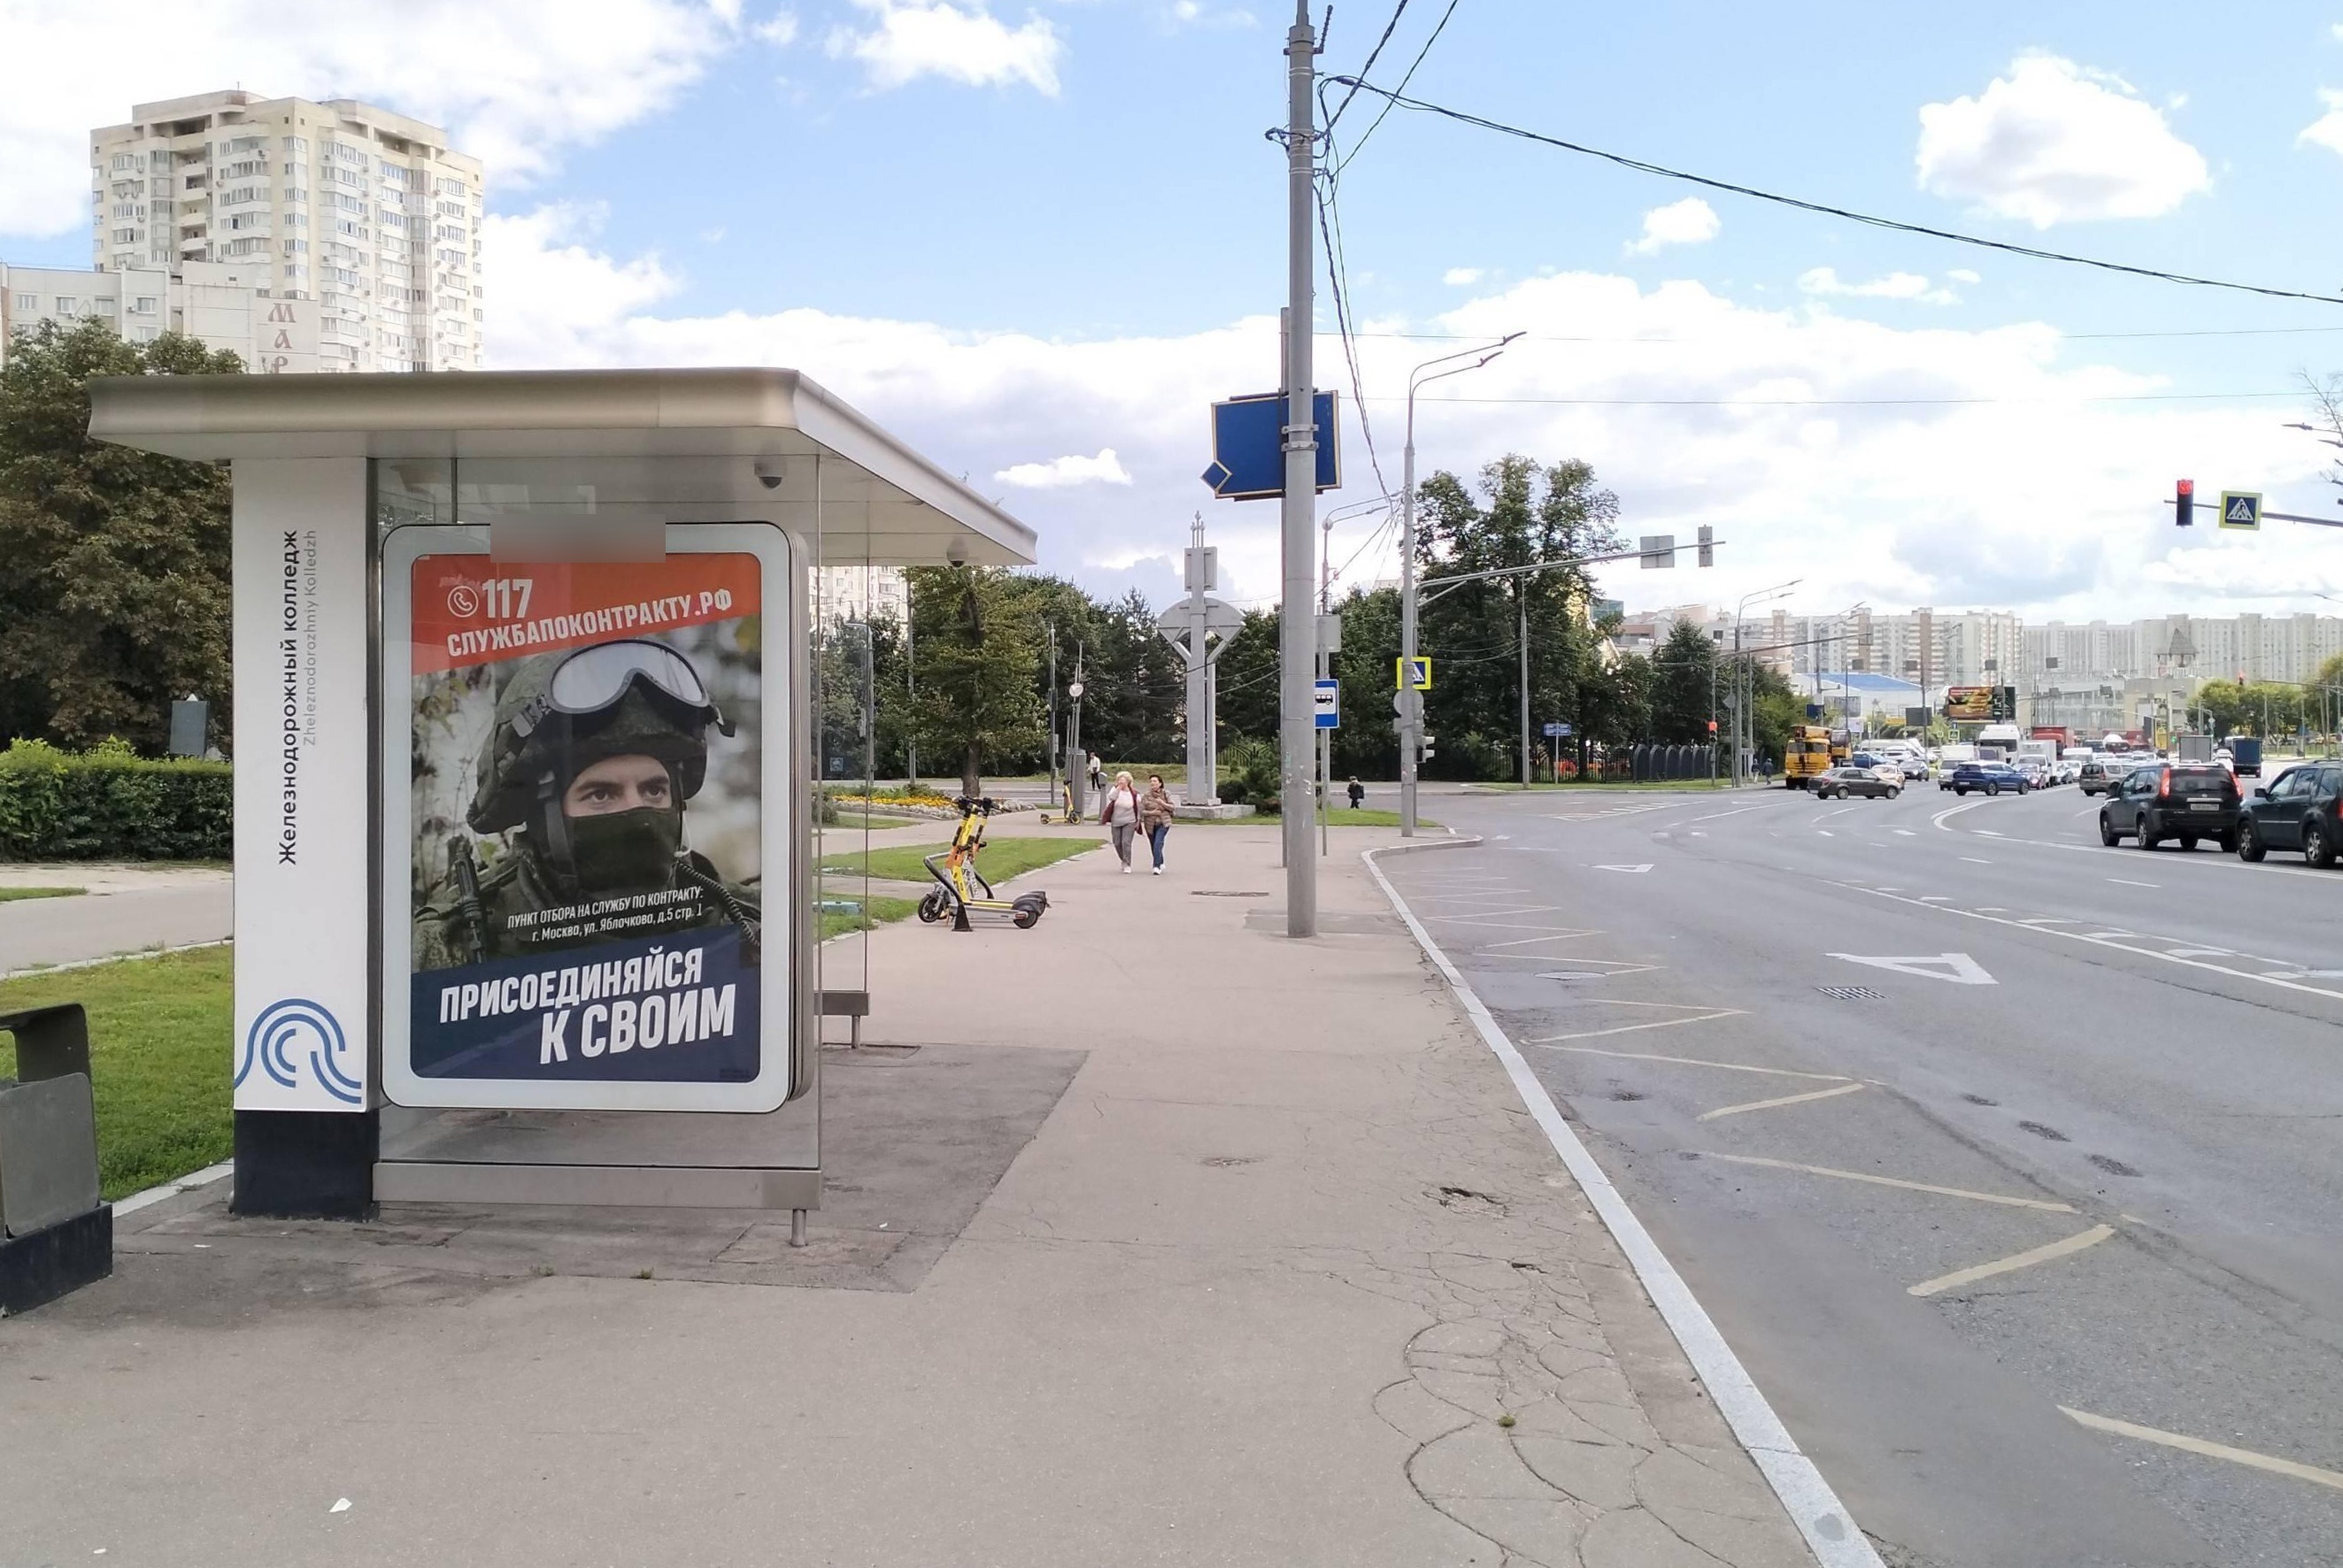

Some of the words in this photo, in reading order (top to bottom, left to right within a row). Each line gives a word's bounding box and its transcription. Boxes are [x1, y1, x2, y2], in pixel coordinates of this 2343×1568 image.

[283, 530, 299, 631] колледж
[304, 530, 317, 596] Kolledzh
[482, 579, 533, 619] 117
[447, 588, 733, 657] СЛУЖБАПОКОНТРАКТУ.РФ
[304, 601, 319, 746] Zheleznodorozhniy
[279, 639, 299, 865] Железнодорожный
[507, 911, 539, 928] ПУНКТ
[540, 905, 575, 923] ОТБОРА
[577, 903, 590, 918] НА
[591, 896, 630, 915] СЛУЖБУ
[632, 894, 645, 909] ПО
[647, 886, 704, 907] КОНТРАКТУ:
[532, 932, 539, 942] г.
[541, 925, 582, 941] Москва,
[583, 922, 598, 937] ул.
[599, 913, 657, 931] Яблочкова,
[674, 906, 695, 921] стр.
[696, 903, 703, 917] 1
[440, 945, 703, 1024] ПРИСОЕДИНЯЙСЯ
[540, 1010, 570, 1065] К
[581, 983, 736, 1058] СВОИМ
